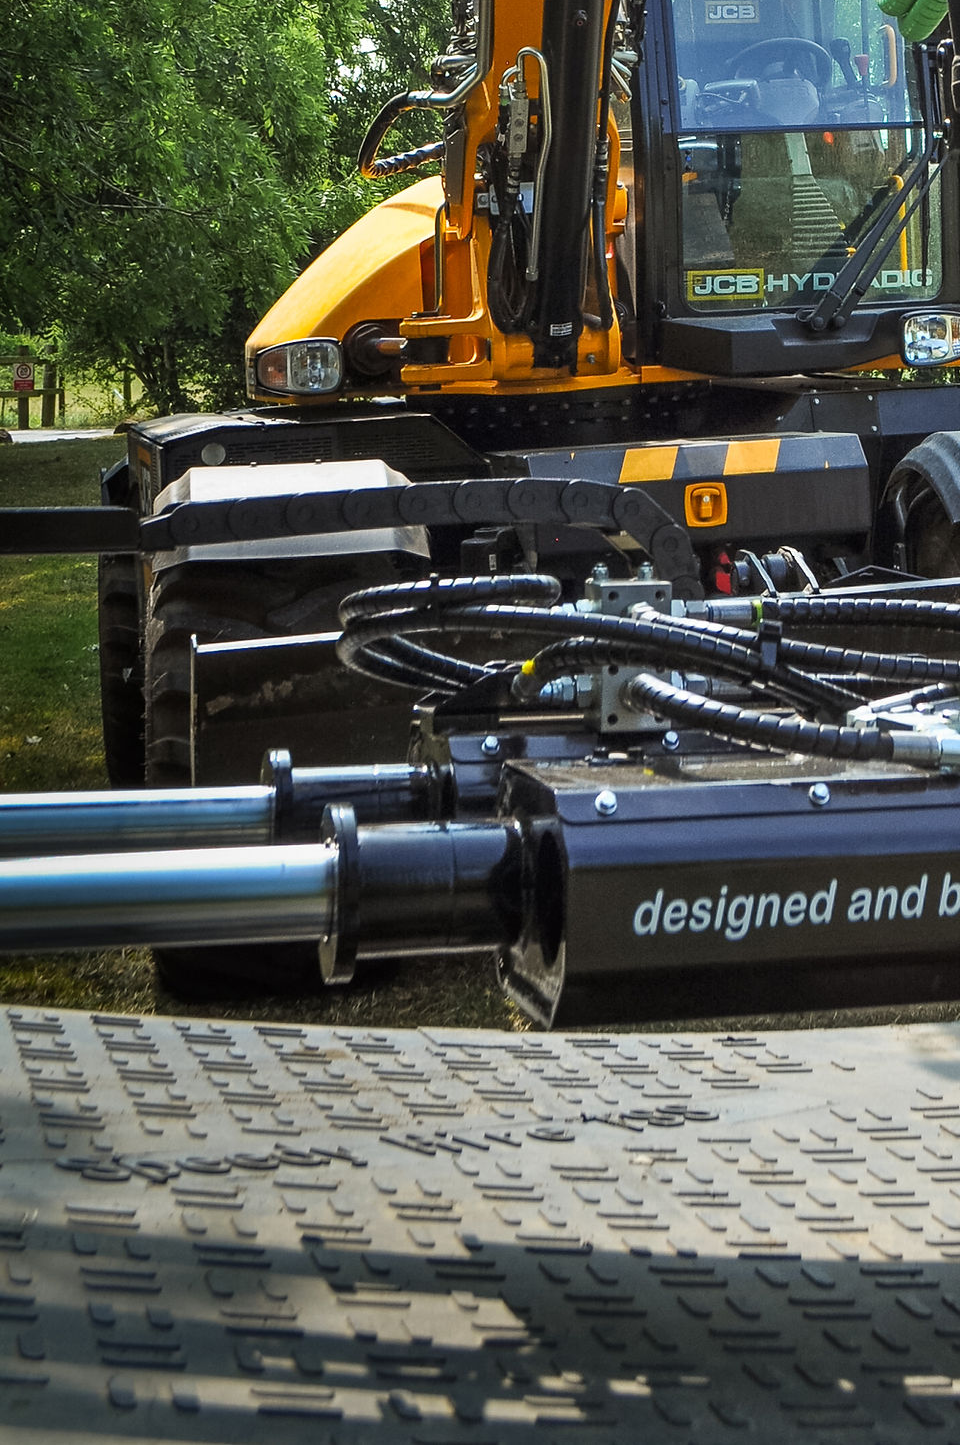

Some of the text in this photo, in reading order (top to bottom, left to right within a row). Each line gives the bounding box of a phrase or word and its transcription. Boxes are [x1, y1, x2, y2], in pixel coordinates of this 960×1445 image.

[709, 5, 755, 19] JCB
[694, 268, 933, 296] JCB HYDDIG
[632, 878, 838, 941] designed
[847, 873, 928, 922] and
